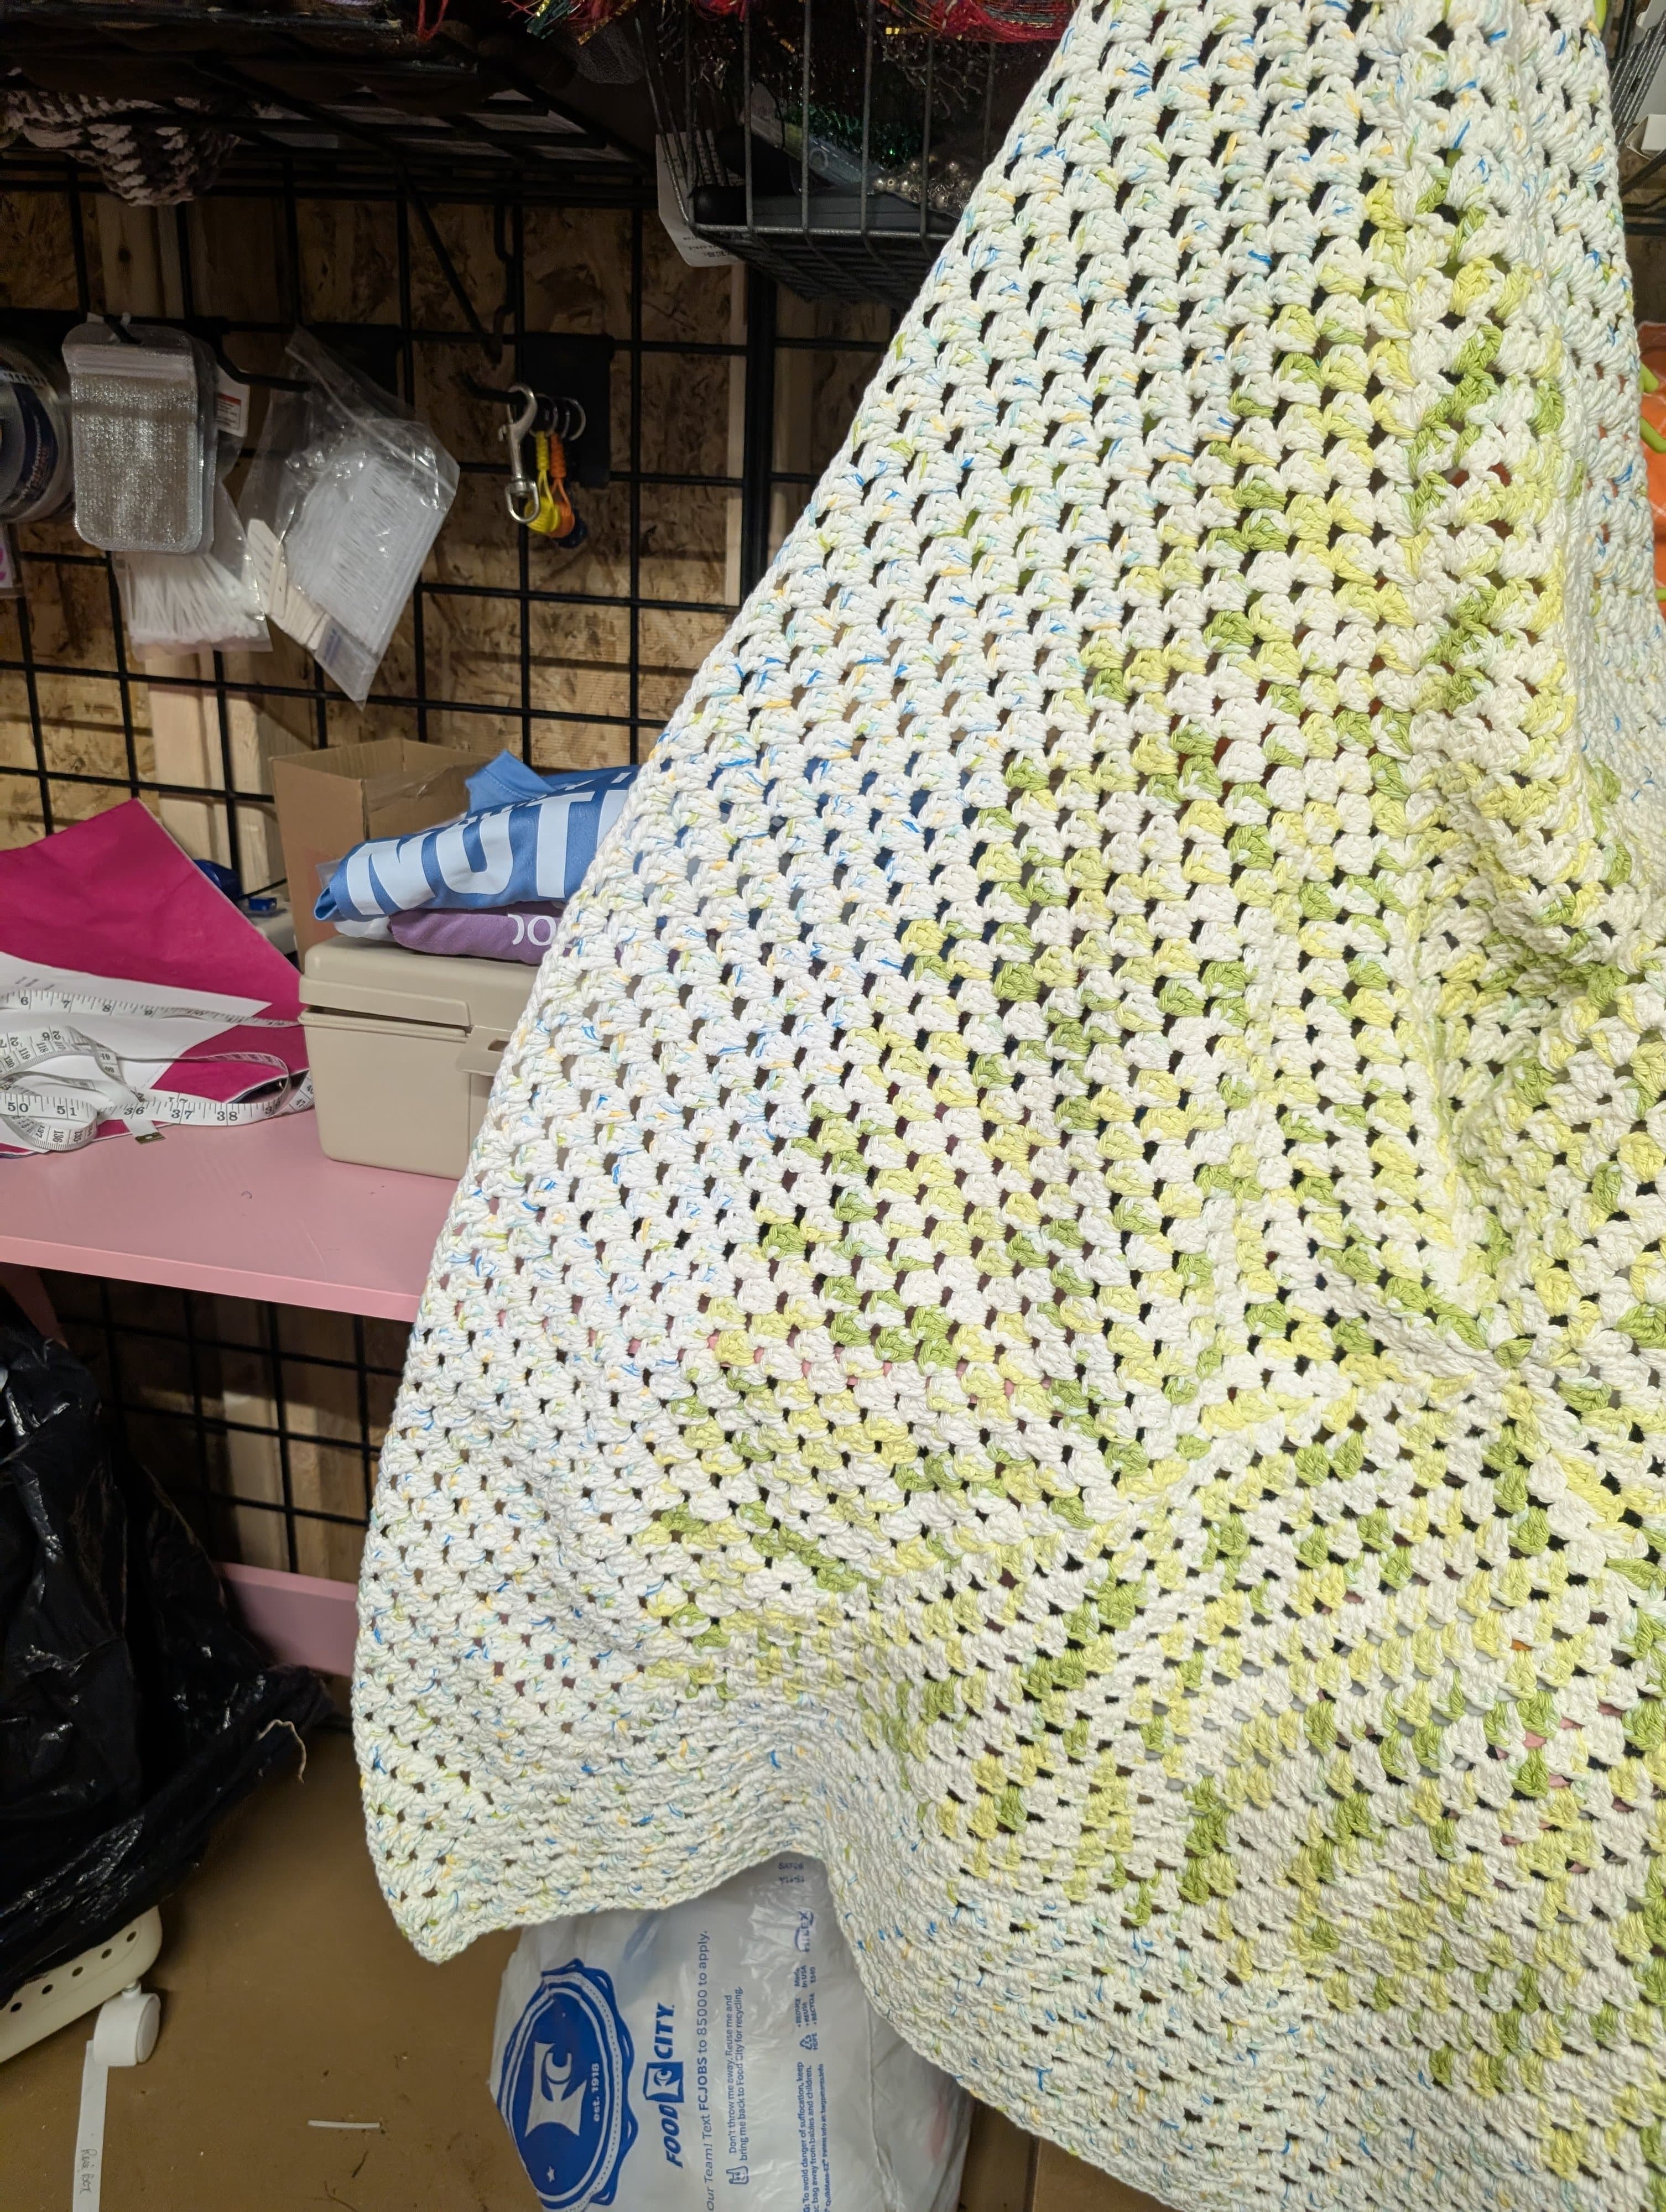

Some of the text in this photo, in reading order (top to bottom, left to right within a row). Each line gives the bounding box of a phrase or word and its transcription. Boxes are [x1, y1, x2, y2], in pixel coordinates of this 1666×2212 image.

[20, 997, 28, 1006] 6
[62, 1000, 71, 1009] 7
[8, 1102, 29, 1113] 50
[56, 1107, 77, 1117] 51
[124, 1107, 145, 1115] 36
[171, 1109, 194, 1120] 37
[216, 1111, 238, 1121] 38
[53, 1130, 64, 1143] 136
[74, 1130, 83, 1142] 135
[726, 2013, 732, 2027] me
[725, 2029, 733, 2056] Reuse
[735, 2030, 743, 2042] for
[735, 2043, 745, 2061] City
[696, 1930, 715, 2211] Our Team! Text FCJOBS to 85000 to apply.
[727, 2058, 735, 2083] away.
[735, 2063, 745, 2085] Food
[591, 2063, 600, 2122] est. 1918
[728, 2085, 735, 2099] me
[737, 2087, 745, 2097] to
[737, 2099, 746, 2120] back
[797, 2083, 806, 2128] suffocation,
[727, 2101, 736, 2128] throw
[740, 2121, 746, 2135] me
[798, 2130, 806, 2138] of
[659, 2104, 683, 2168] FOOD
[728, 2130, 737, 2153] Don't
[739, 2137, 749, 2161] bring
[801, 2140, 810, 2168] danger
[802, 2193, 810, 2201] To
